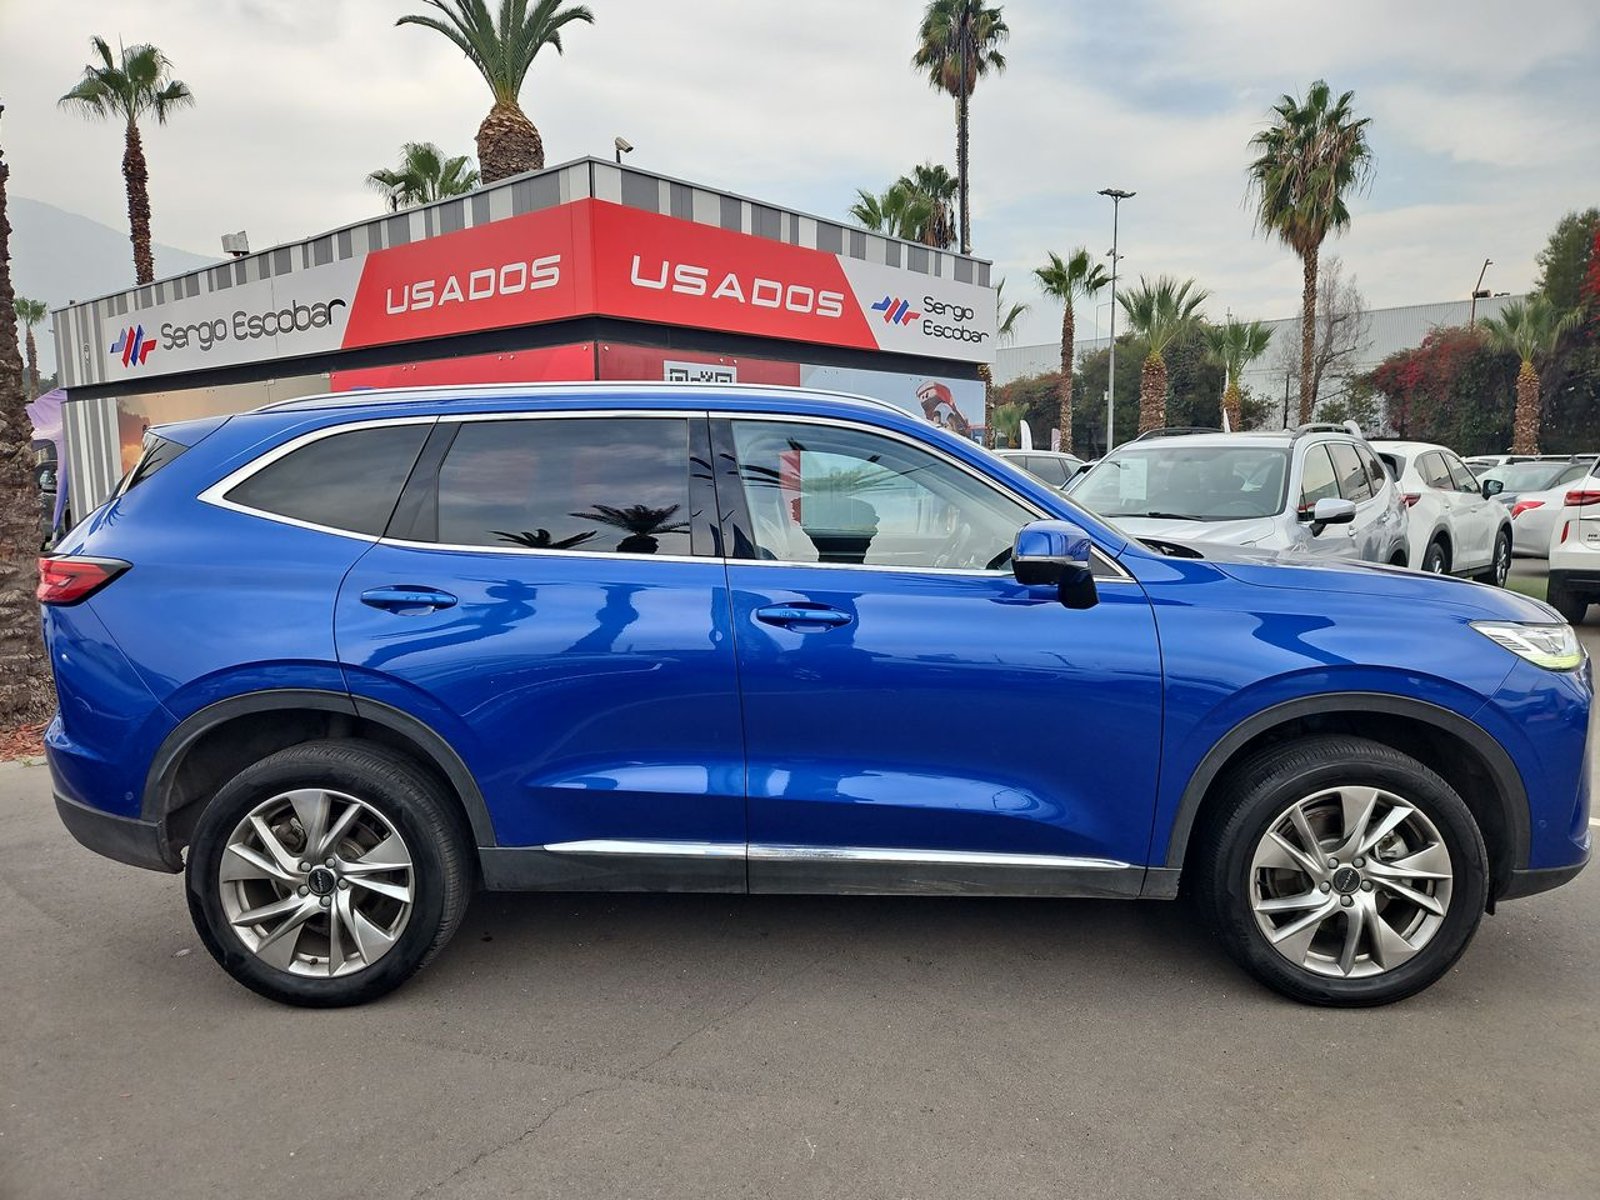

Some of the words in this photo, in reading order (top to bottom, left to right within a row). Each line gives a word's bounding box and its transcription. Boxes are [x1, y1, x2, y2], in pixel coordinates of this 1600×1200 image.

[386, 254, 561, 315] USADOS
[630, 254, 845, 318] USADOS
[923, 295, 975, 322] Sergio
[161, 318, 227, 351] Sergio
[232, 299, 346, 341] Escobar
[923, 319, 990, 343] Escobar
